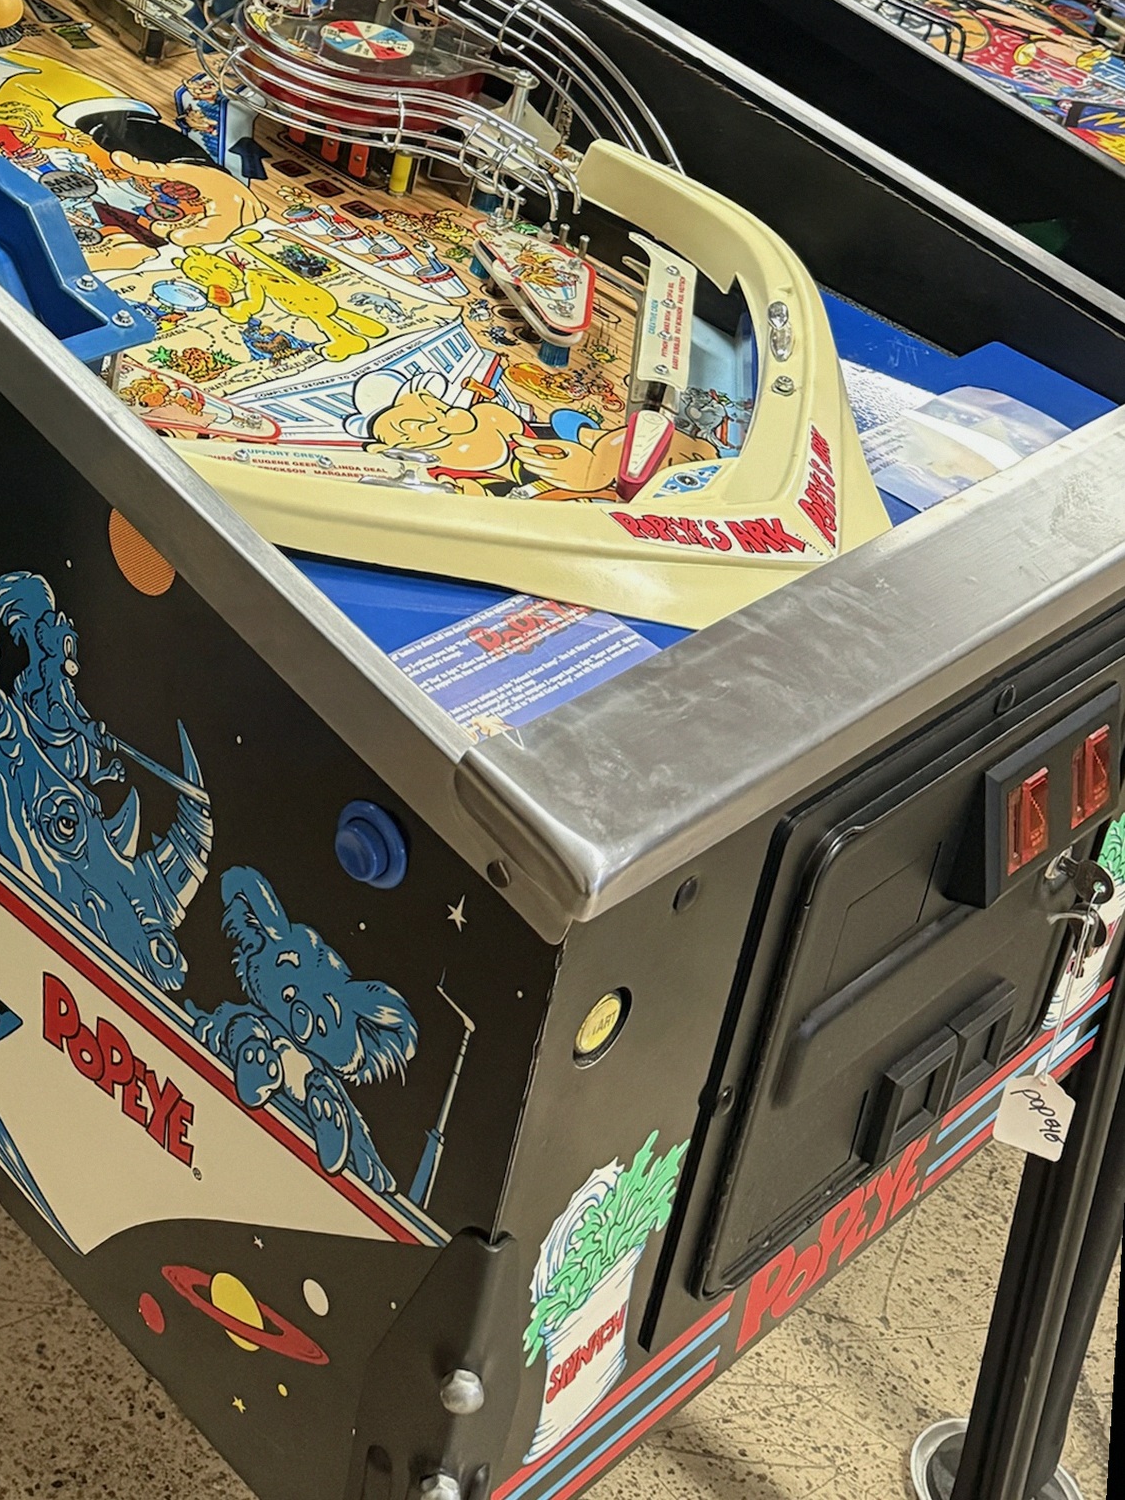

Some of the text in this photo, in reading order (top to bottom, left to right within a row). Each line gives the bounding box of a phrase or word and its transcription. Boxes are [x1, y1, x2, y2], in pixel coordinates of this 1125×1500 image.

[44, 174, 82, 187] SAVE
[50, 179, 94, 194] OLIVE
[254, 386, 298, 399] COMPLETE
[241, 448, 289, 458] UPPORT
[251, 458, 287, 467] EUGENE
[609, 511, 732, 551] POPEYE'S
[725, 516, 806, 553] ARK
[43, 971, 194, 1168] POPEYE
[735, 1132, 932, 1353] POPEYE
[546, 1299, 629, 1404] SPINACH
